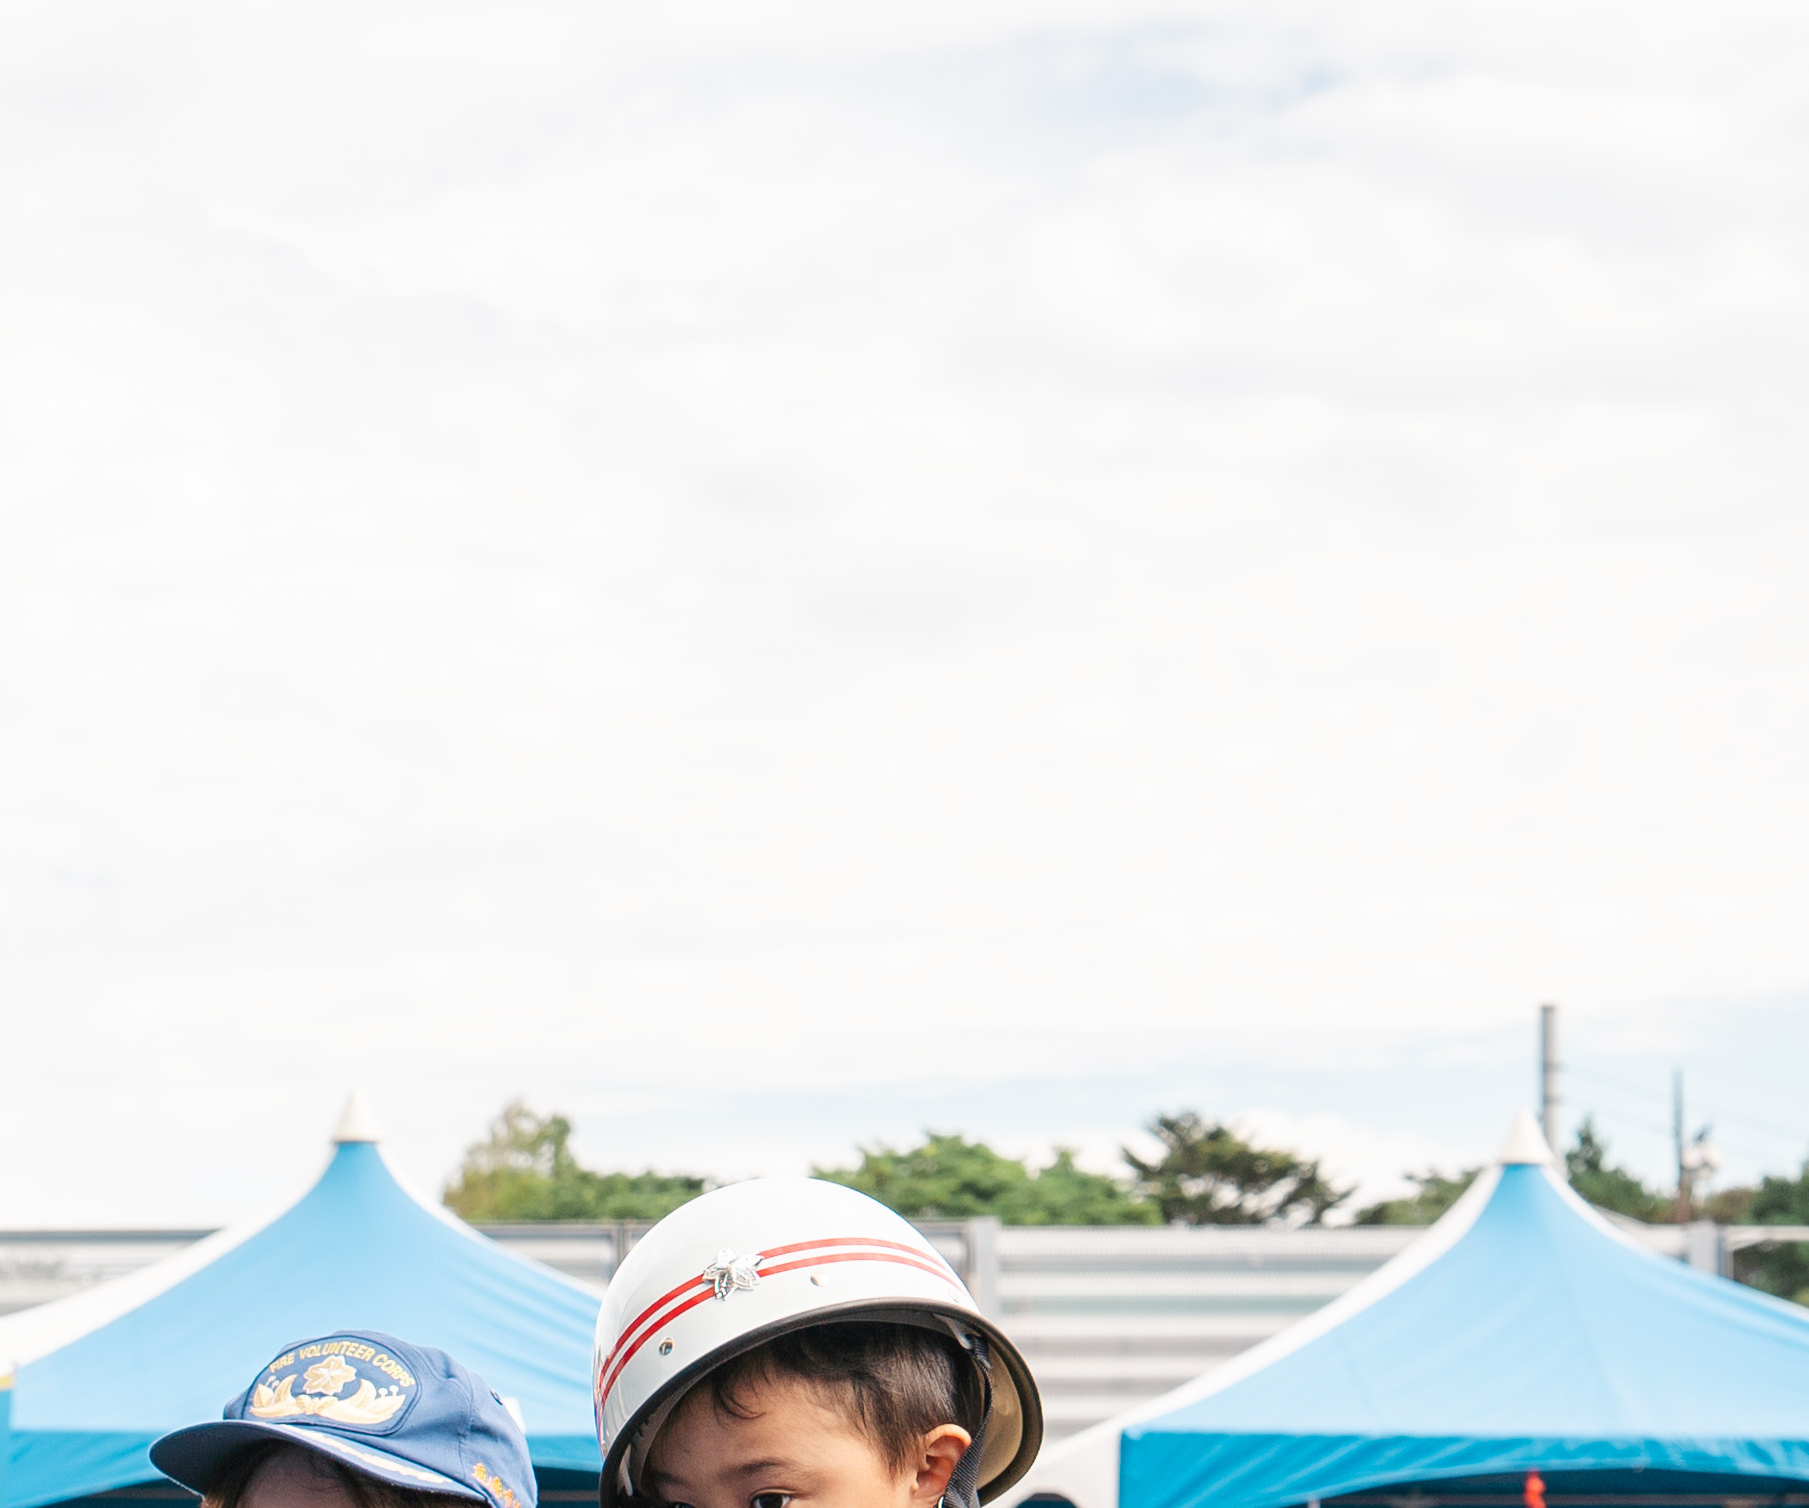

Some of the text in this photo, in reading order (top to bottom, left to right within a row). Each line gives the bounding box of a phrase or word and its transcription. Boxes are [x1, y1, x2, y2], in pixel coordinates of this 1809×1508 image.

[269, 1340, 416, 1388] FIRE VOLUNTEER CORPS
